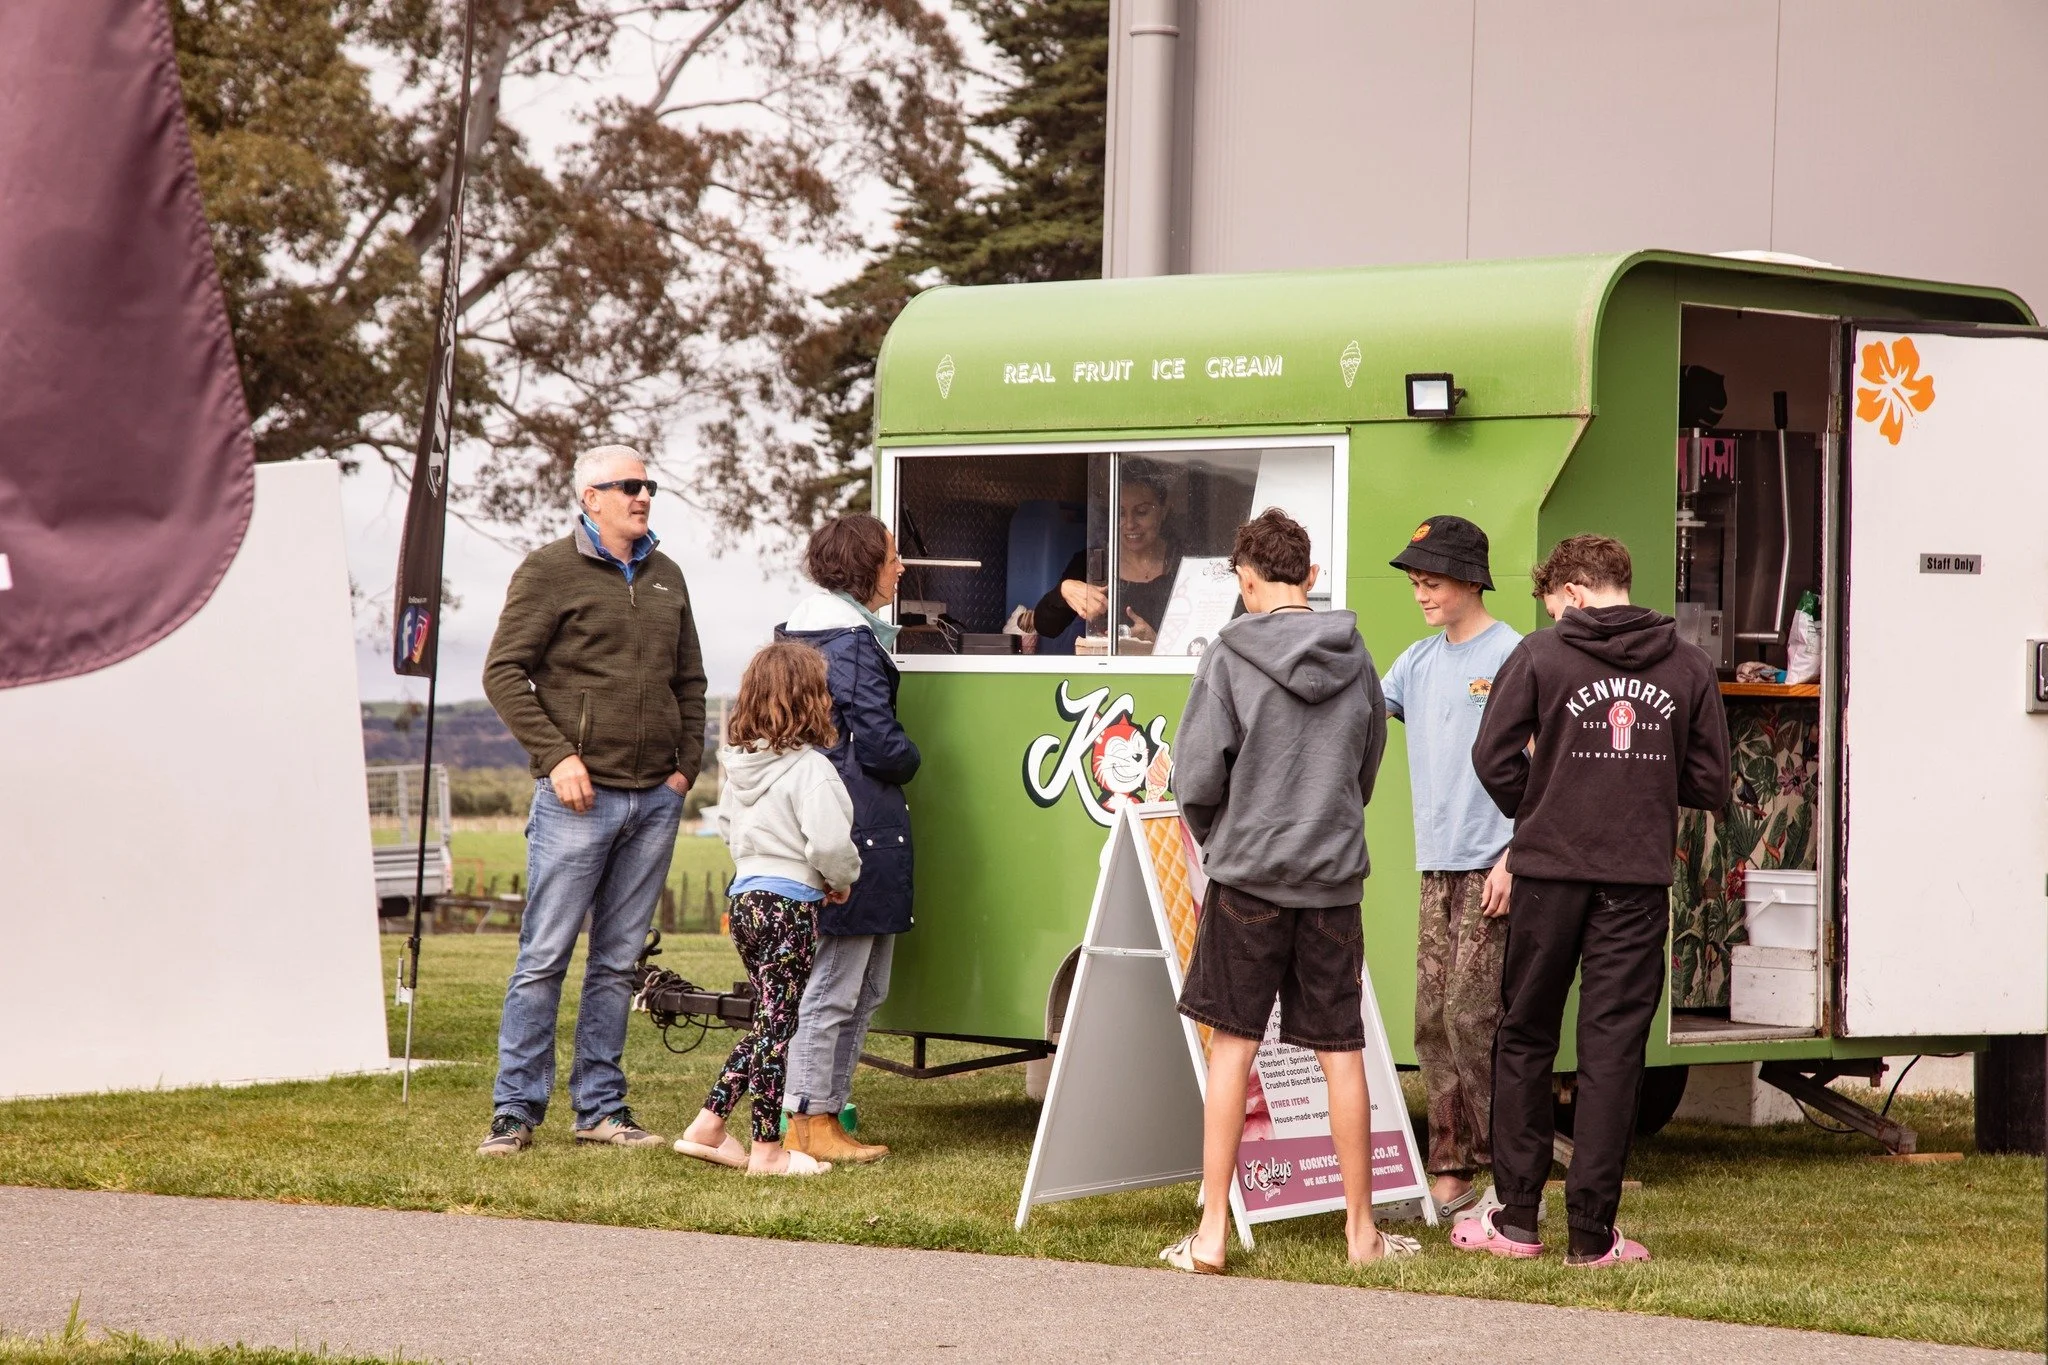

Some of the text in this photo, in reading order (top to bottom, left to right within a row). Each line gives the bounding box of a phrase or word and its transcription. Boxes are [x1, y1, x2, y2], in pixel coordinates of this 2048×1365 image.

[1003, 354, 1283, 384] REAL FRUIT ICE CREAM
[1927, 557, 1974, 572] Staff Only
[1565, 677, 1677, 720] KENWORTH
[1582, 721, 1607, 729] ESTD
[1642, 753, 1667, 761] BEST
[1257, 1050, 1273, 1058] Flake
[1276, 1047, 1290, 1055] Mini
[1259, 1054, 1317, 1069] Sherbert Sprinkles
[1262, 1069, 1286, 1079] Toasted
[1286, 1066, 1310, 1076] coconut
[1265, 1079, 1290, 1090] Crushed
[1290, 1076, 1311, 1087] Biscoff
[1270, 1096, 1310, 1109] OTHER ITEMS
[1274, 1110, 1330, 1124] House-made vegan
[1303, 1177, 1315, 1187] WE
[1315, 1175, 1328, 1186] ARE
[1371, 1163, 1404, 1177] FUNCTIONS
